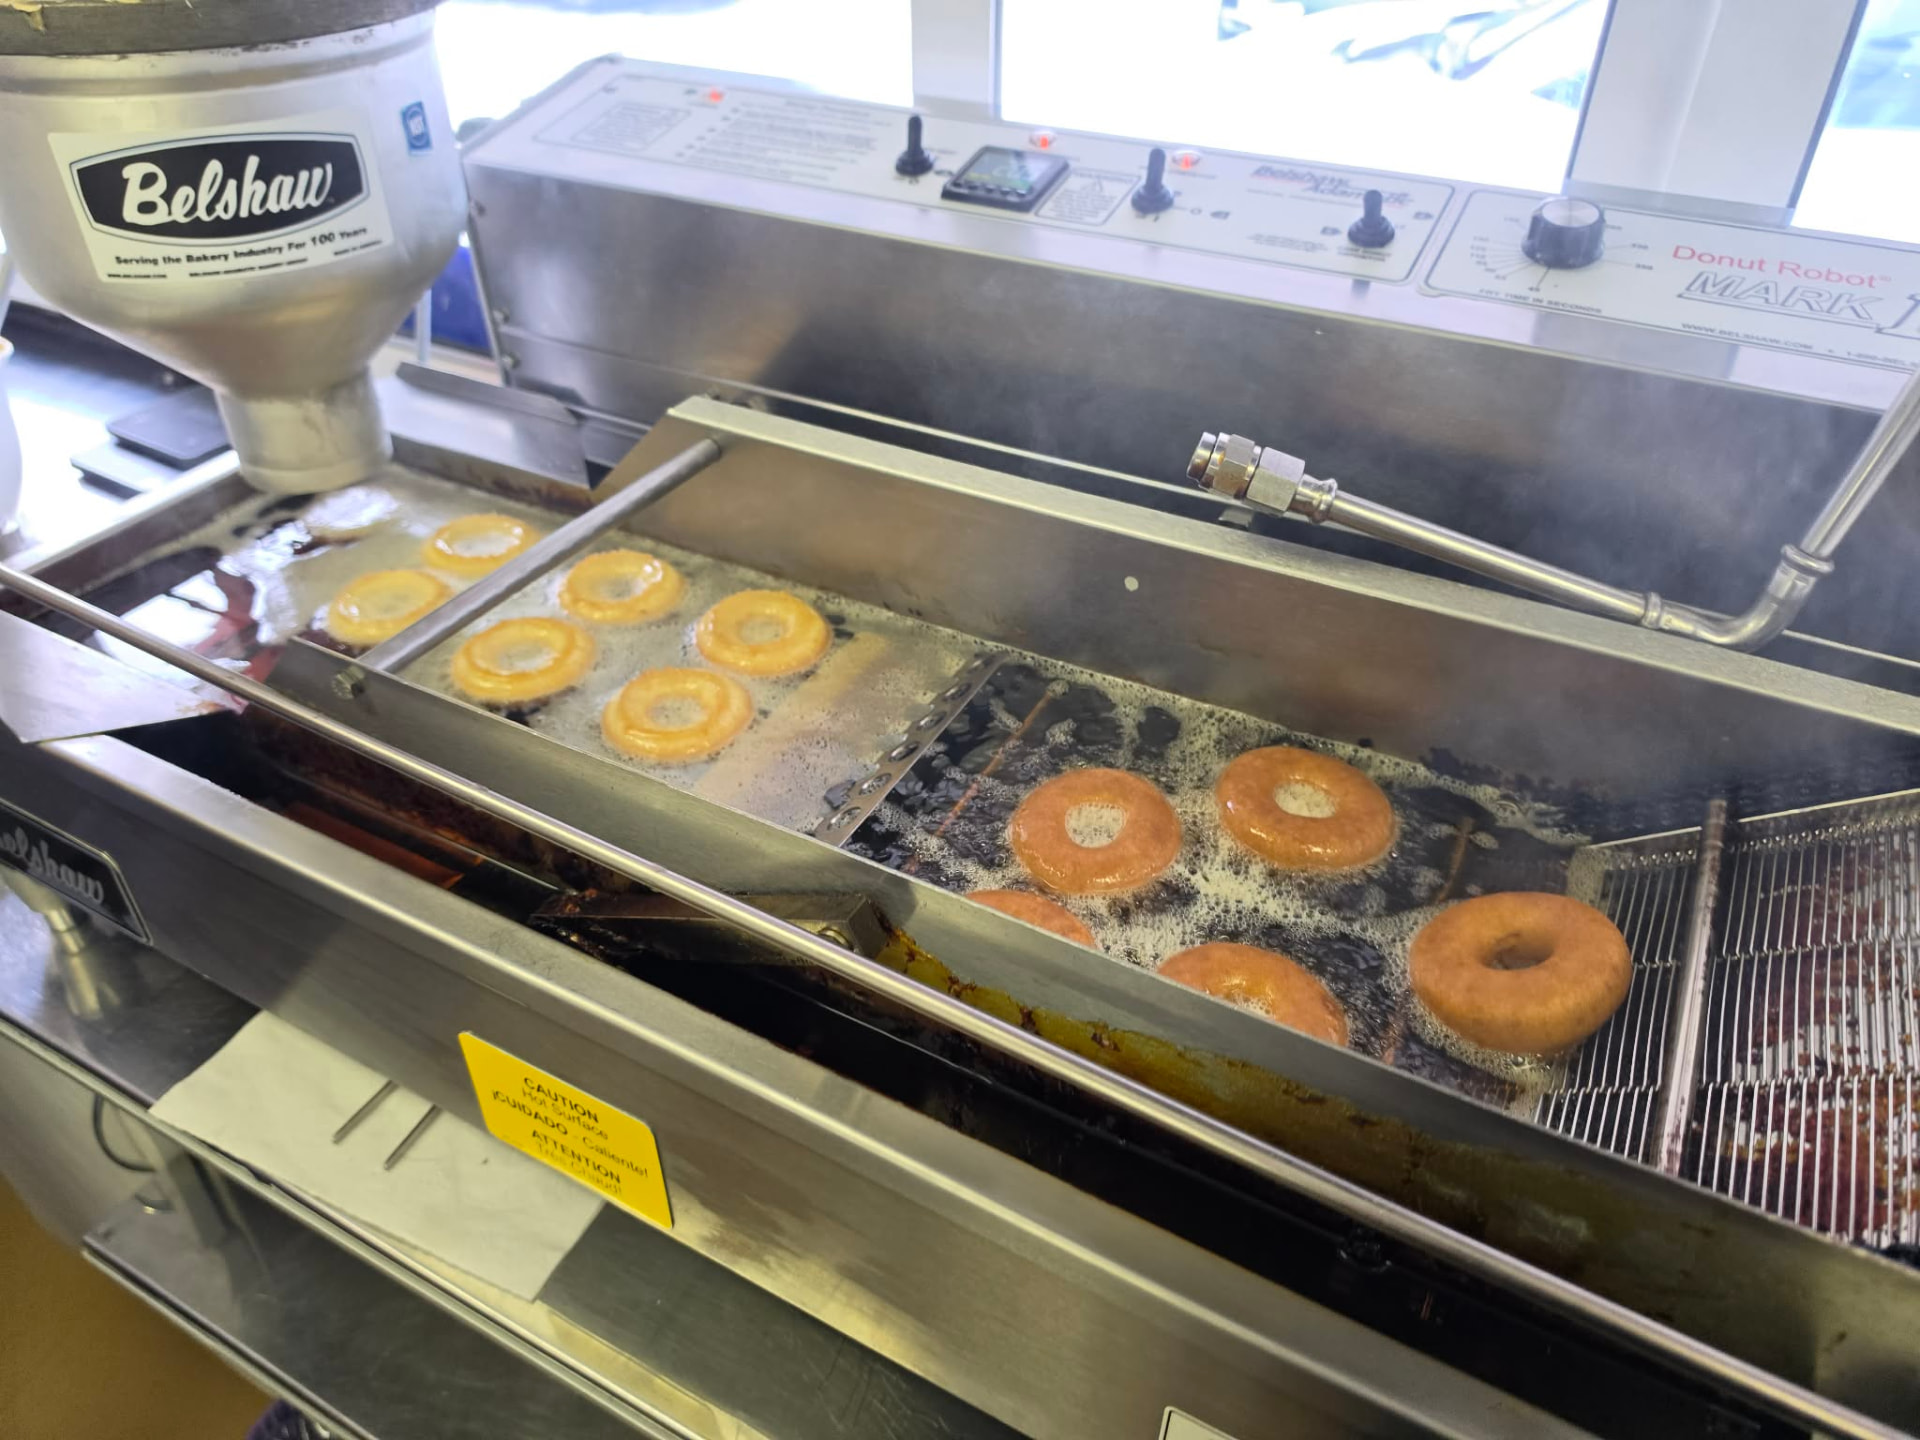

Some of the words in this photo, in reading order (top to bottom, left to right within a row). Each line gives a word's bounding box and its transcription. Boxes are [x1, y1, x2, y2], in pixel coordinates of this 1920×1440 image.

[122, 155, 333, 226] Belshaw
[115, 255, 159, 266] Serving
[162, 255, 182, 265] the
[186, 252, 229, 263] Bakery
[233, 246, 283, 259] Industry
[287, 241, 306, 251] For
[311, 232, 335, 247] 100
[1672, 244, 1767, 273] Donut
[1685, 270, 1884, 321] MARK
[0, 826, 104, 905] elshaw
[521, 1087, 549, 1110] Hot
[551, 1102, 609, 1141] Surface
[523, 1077, 599, 1124] CAUTION
[532, 1129, 621, 1184] ATTENTION
[582, 1136, 649, 1178] Caliente!
